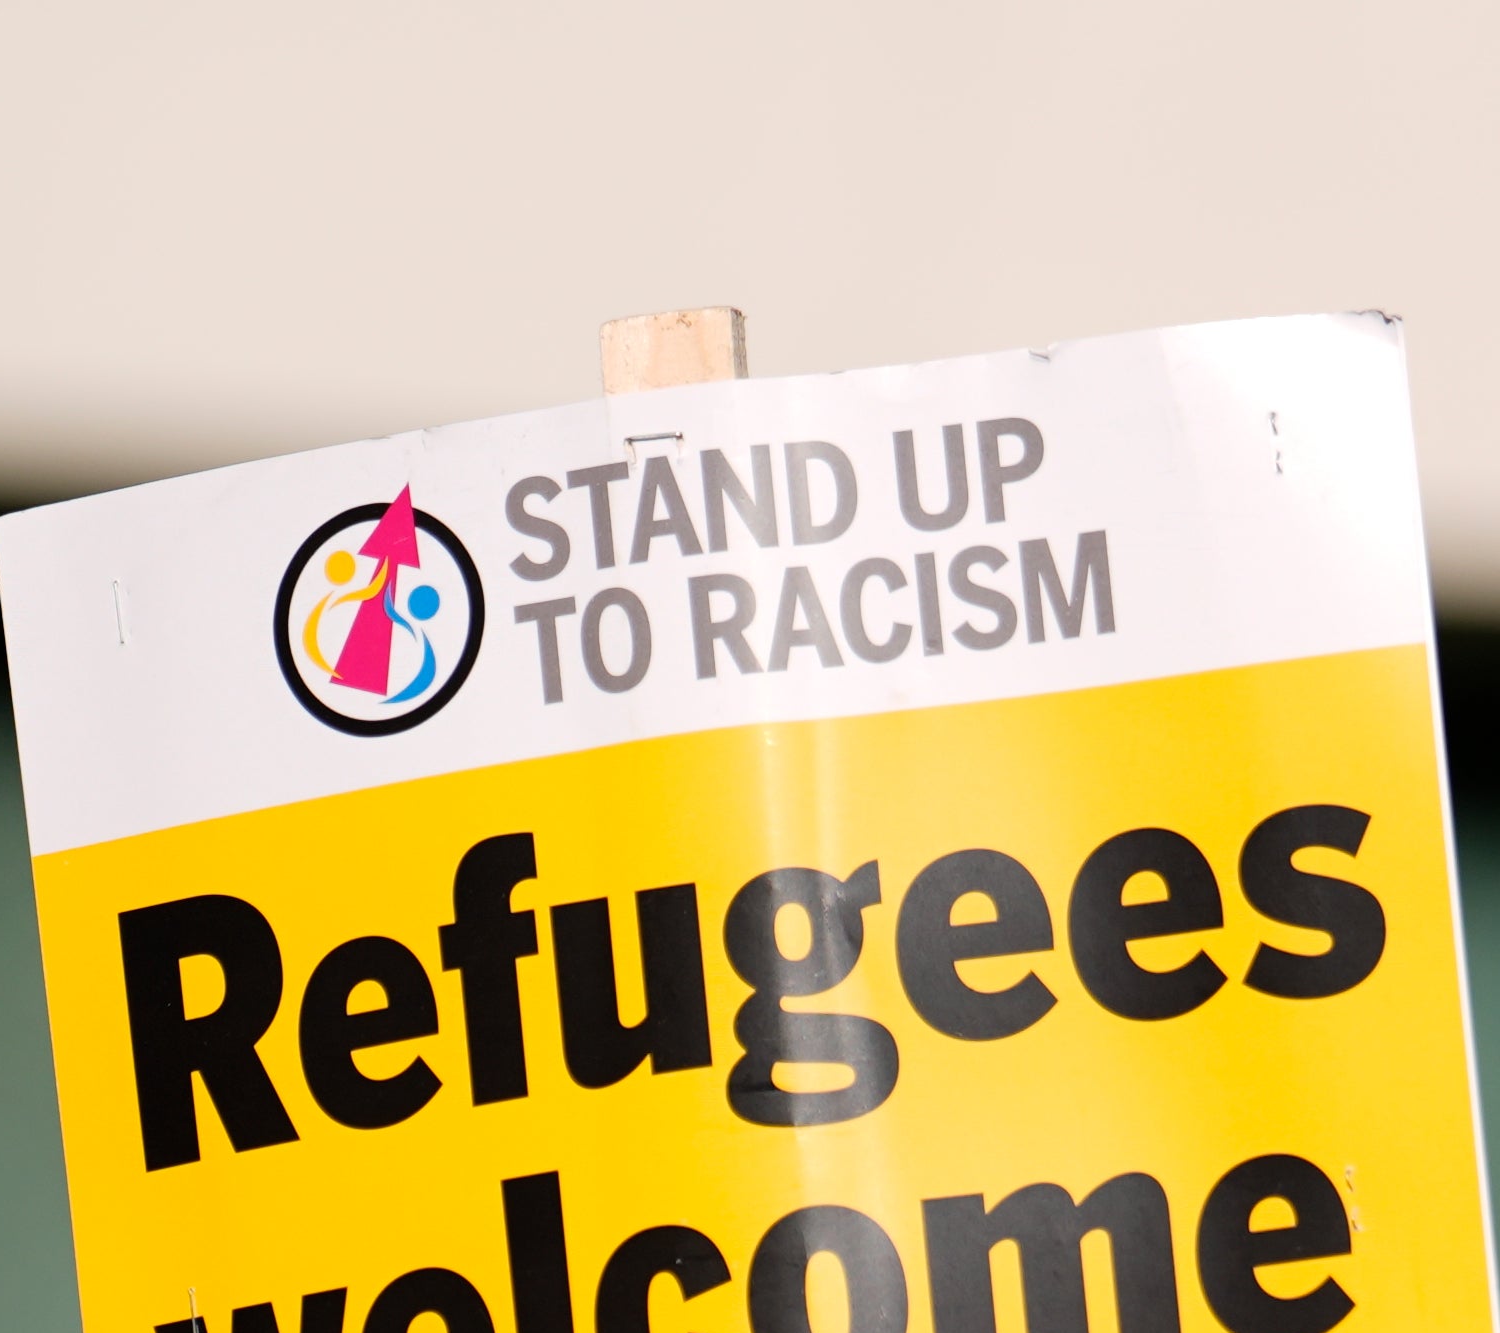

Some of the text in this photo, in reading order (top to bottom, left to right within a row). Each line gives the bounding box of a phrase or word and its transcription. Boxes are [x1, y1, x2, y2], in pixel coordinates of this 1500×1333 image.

[504, 416, 1045, 582] STAND UP
[513, 529, 1117, 706] TO RACISM
[116, 801, 1388, 1173] Refugees
